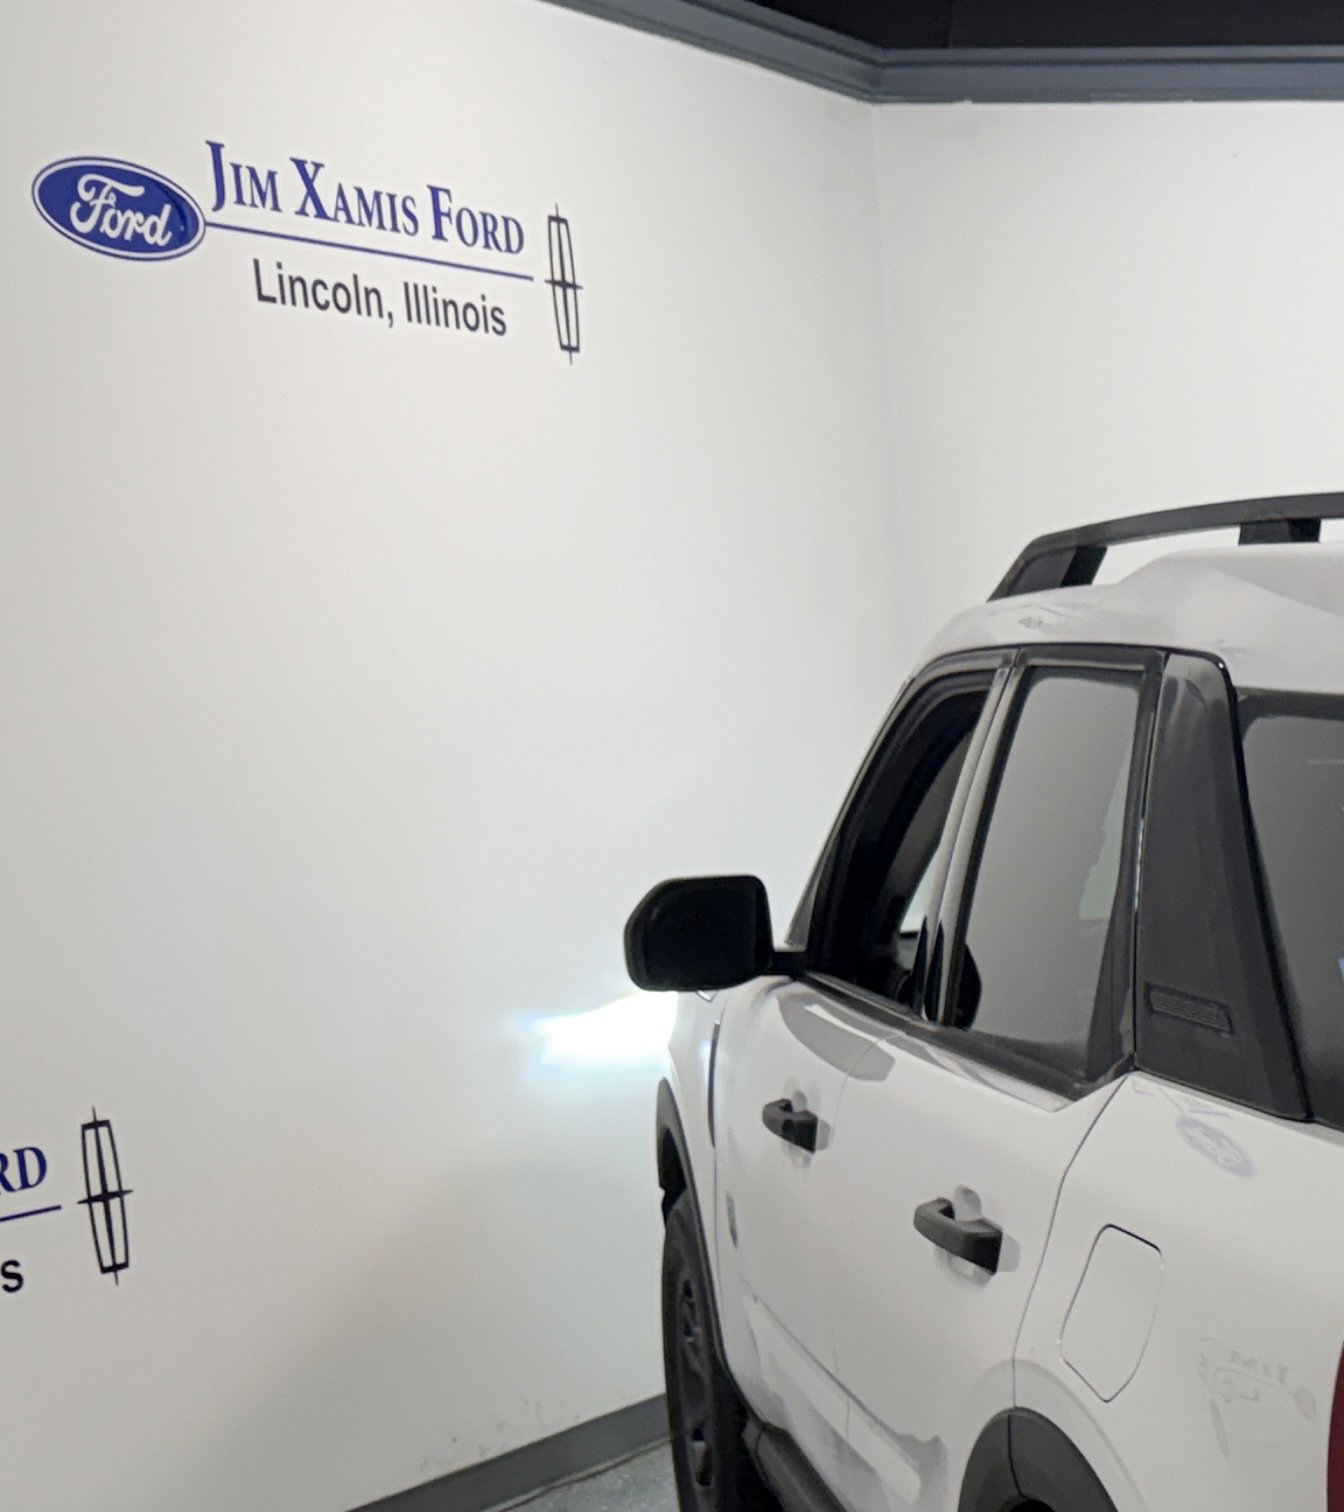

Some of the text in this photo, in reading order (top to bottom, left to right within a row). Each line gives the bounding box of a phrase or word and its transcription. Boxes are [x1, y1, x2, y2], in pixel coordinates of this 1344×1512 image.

[68, 173, 173, 247] Ford
[205, 140, 525, 256] JIM XAMIS FORD
[253, 258, 508, 336] Lincoln, Illinois
